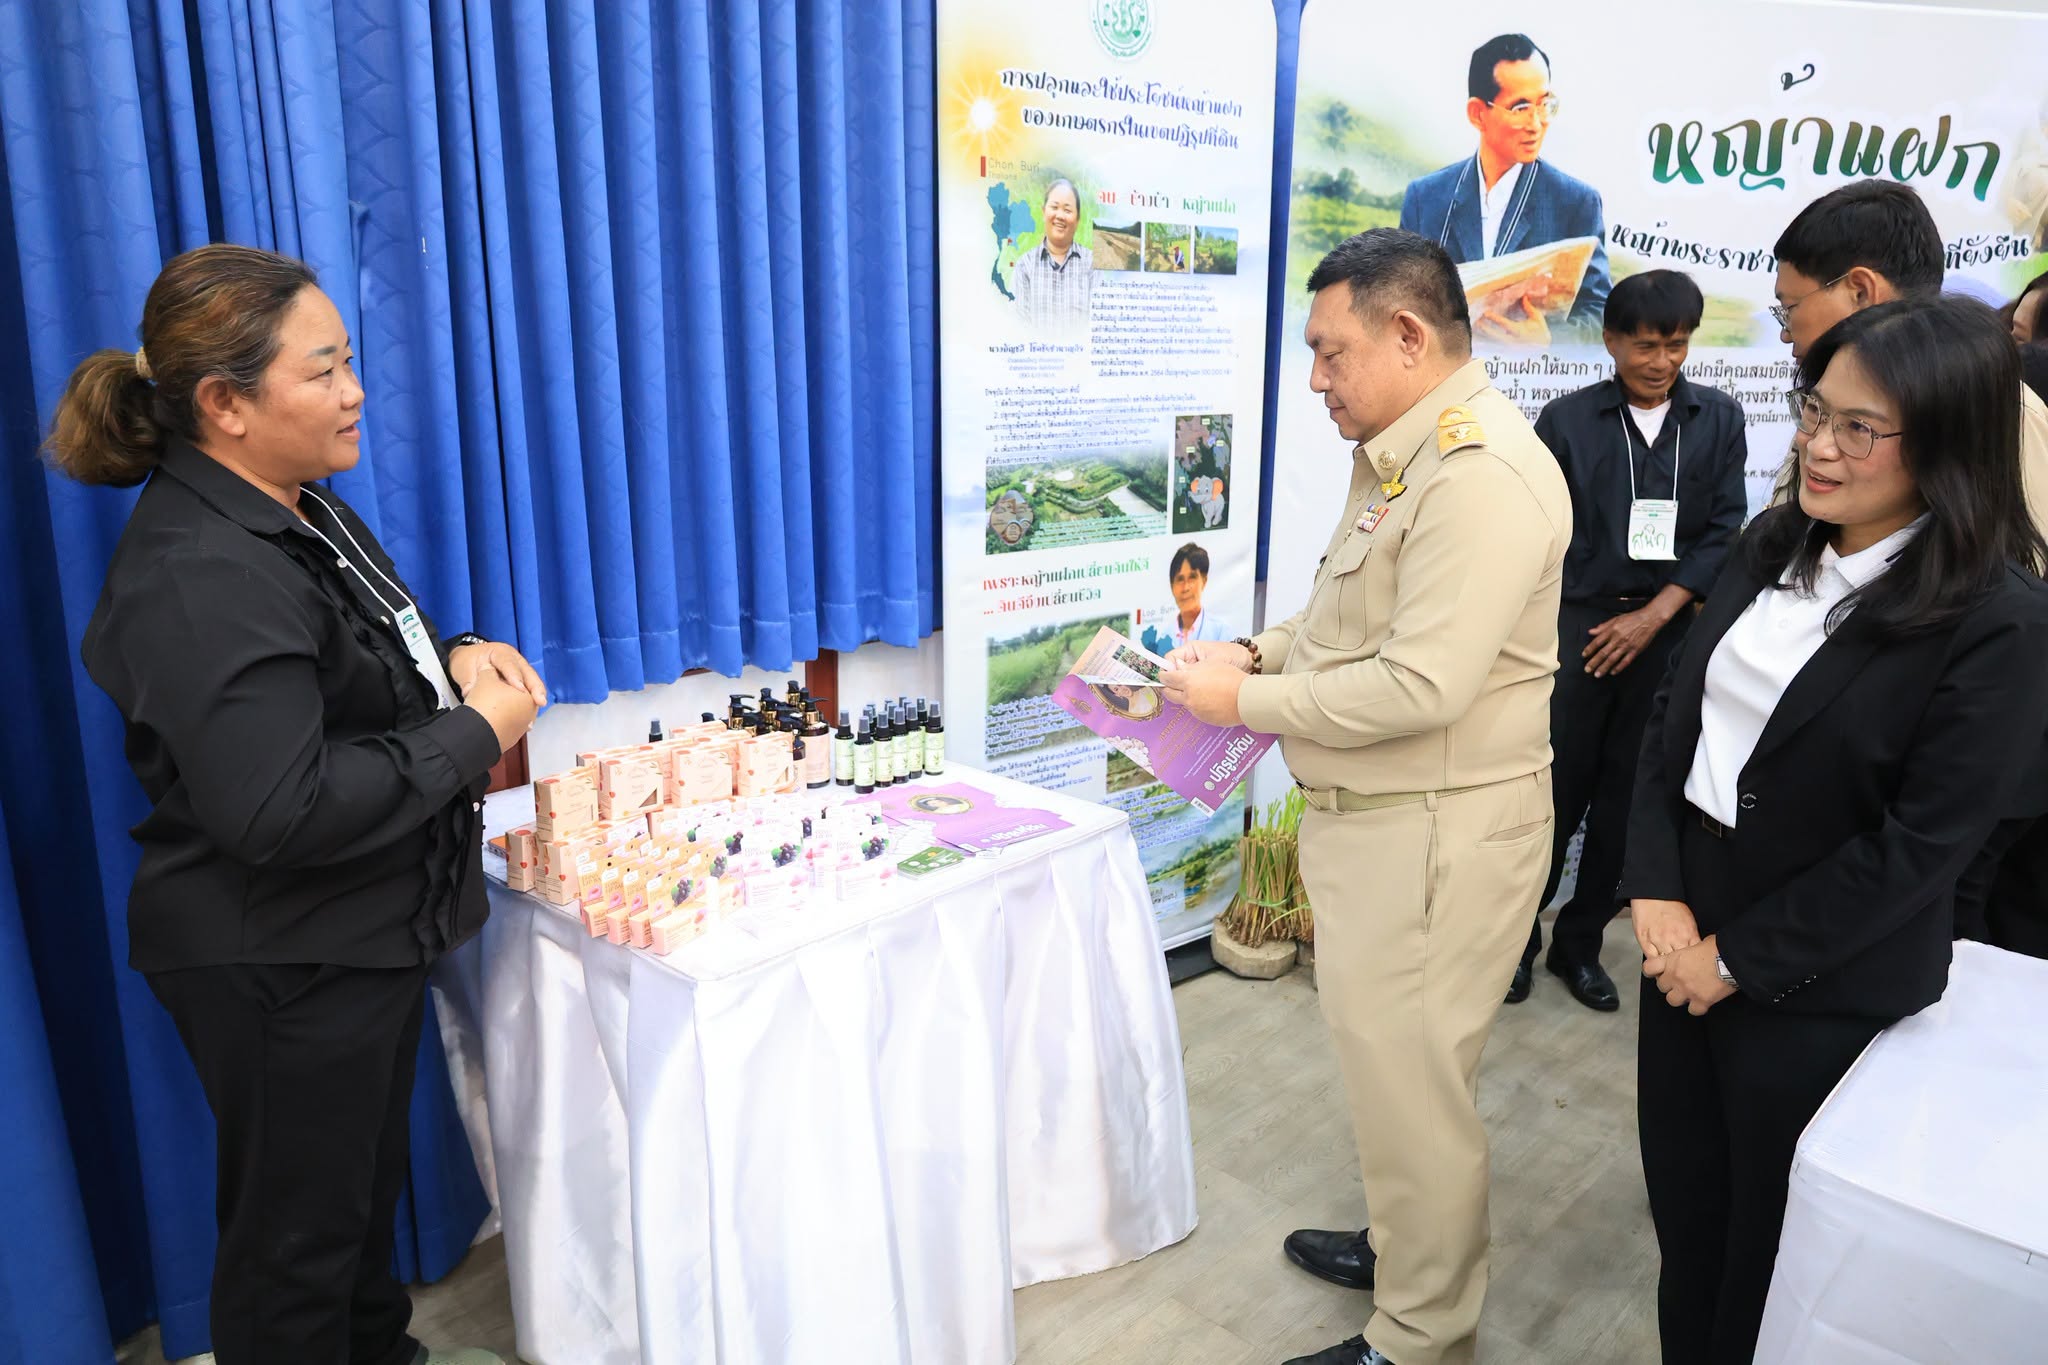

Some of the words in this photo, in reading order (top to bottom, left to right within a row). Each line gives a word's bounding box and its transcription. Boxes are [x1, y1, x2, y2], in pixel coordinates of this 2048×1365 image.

[1648, 63, 2000, 202] หญ้าแฝก
[1611, 221, 1780, 273] หญ้าพระราชา
[1485, 354, 1588, 379] ญ้าแฝกให้มาก
